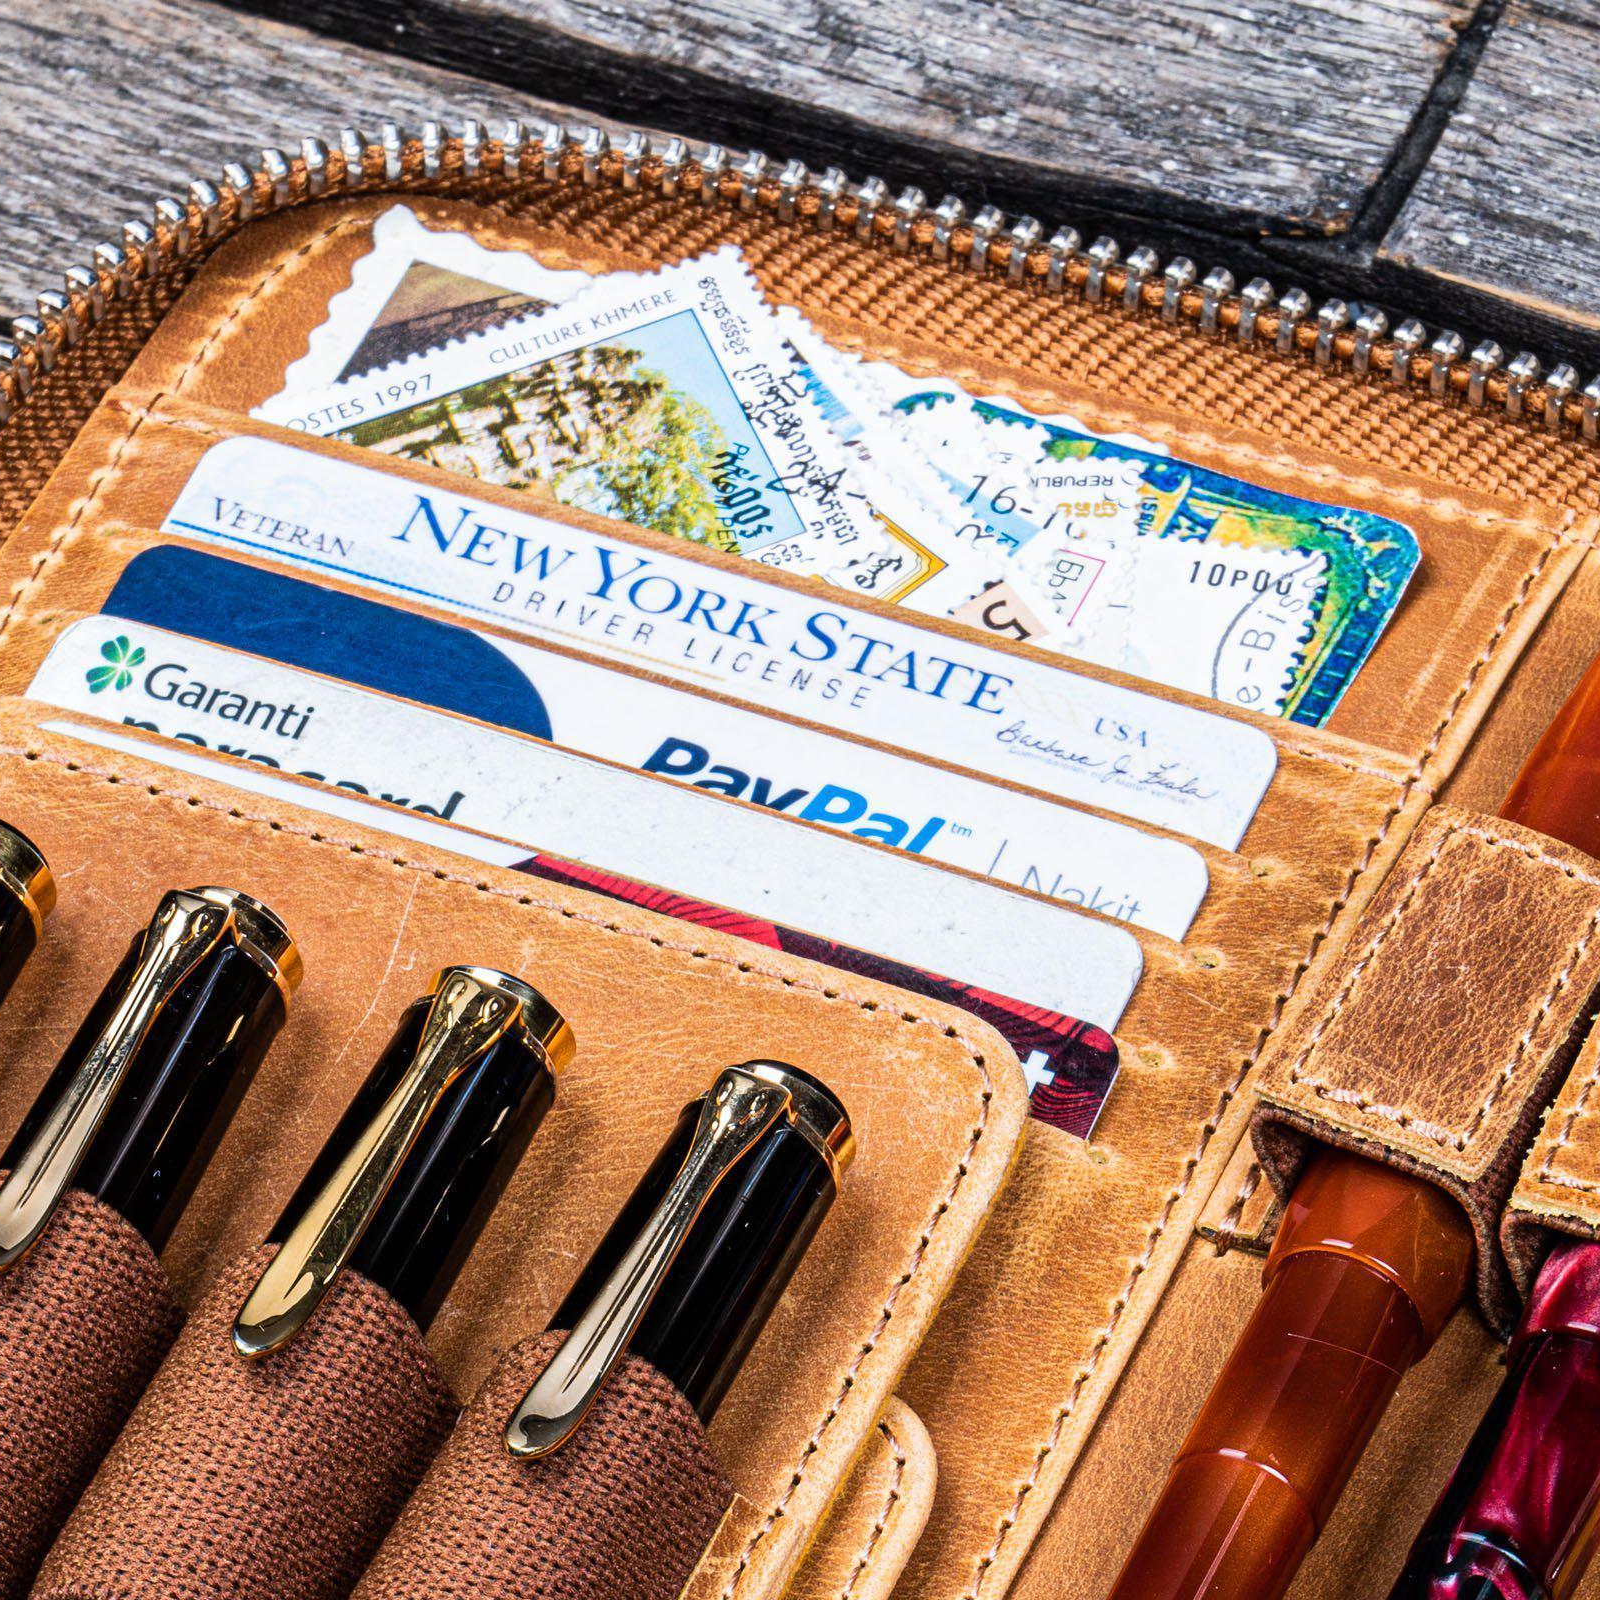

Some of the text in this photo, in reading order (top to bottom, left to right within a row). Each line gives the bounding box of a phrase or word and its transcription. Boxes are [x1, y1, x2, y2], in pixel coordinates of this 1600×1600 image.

[286, 288, 679, 433] OSTES 1997 CULTURE KHMERE
[212, 496, 356, 558] VETERAN
[712, 515, 743, 557] PEN
[390, 493, 1017, 715] NEW YORK STATE
[494, 580, 874, 709] DRIVER LICENSE
[143, 662, 317, 741] Garanti
[1094, 717, 1149, 748] USA
